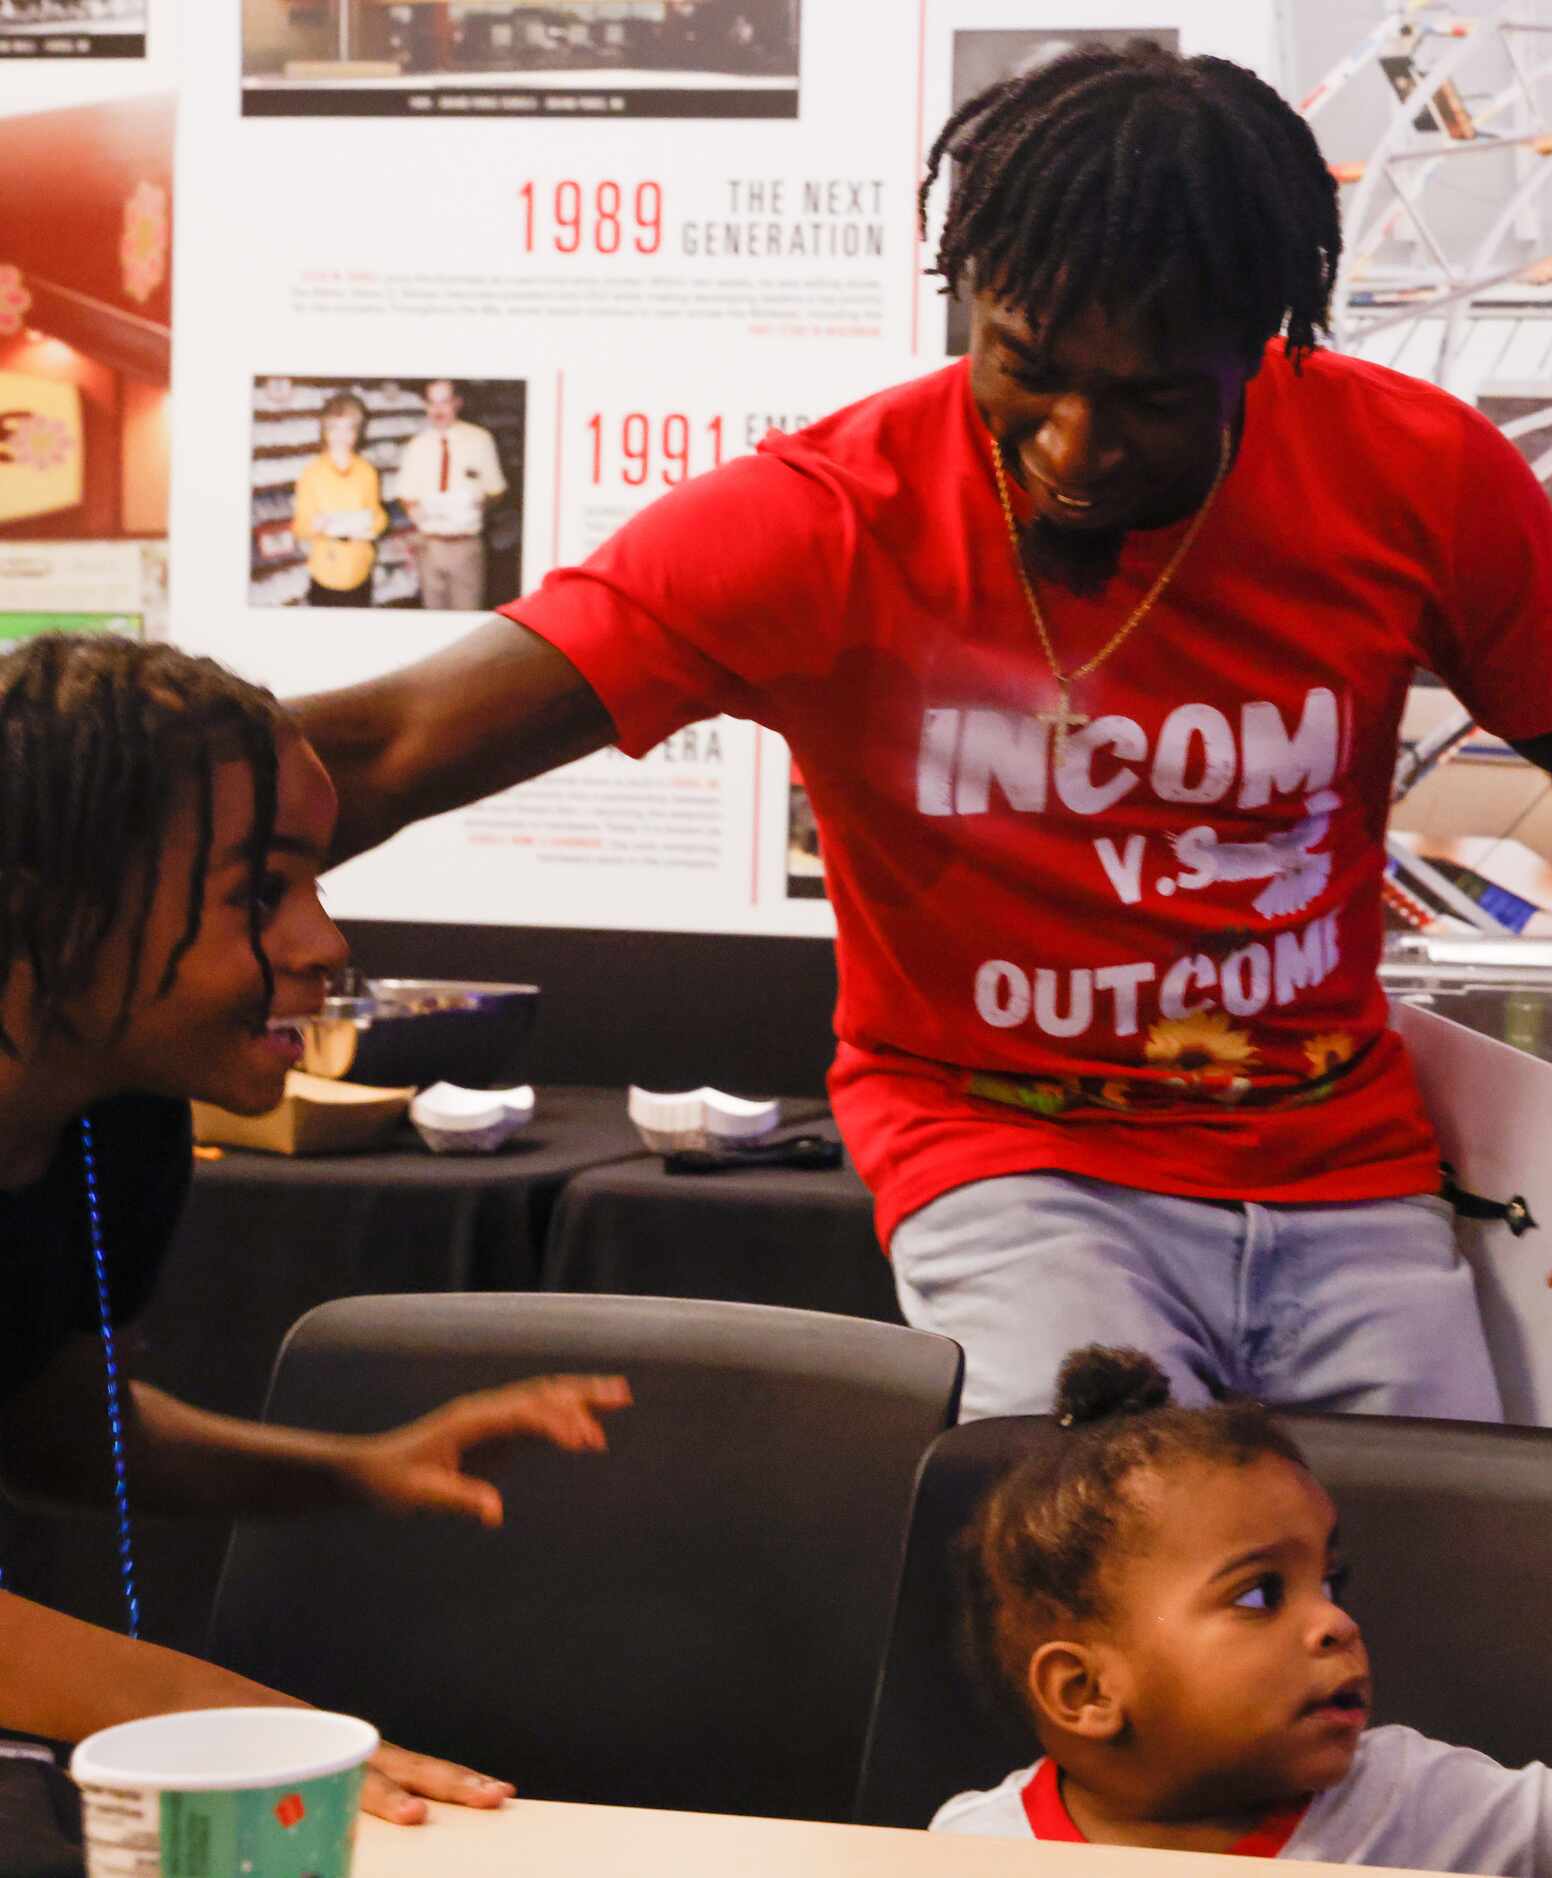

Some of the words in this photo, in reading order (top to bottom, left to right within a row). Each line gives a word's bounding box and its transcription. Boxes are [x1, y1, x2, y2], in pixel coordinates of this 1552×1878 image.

[519, 180, 663, 254] 1989
[728, 180, 785, 214] THE
[804, 180, 886, 214] NEXT
[682, 222, 886, 257] GENERATION
[586, 412, 723, 486] 1991
[664, 728, 723, 763] ERA
[917, 687, 1354, 816] INCOM
